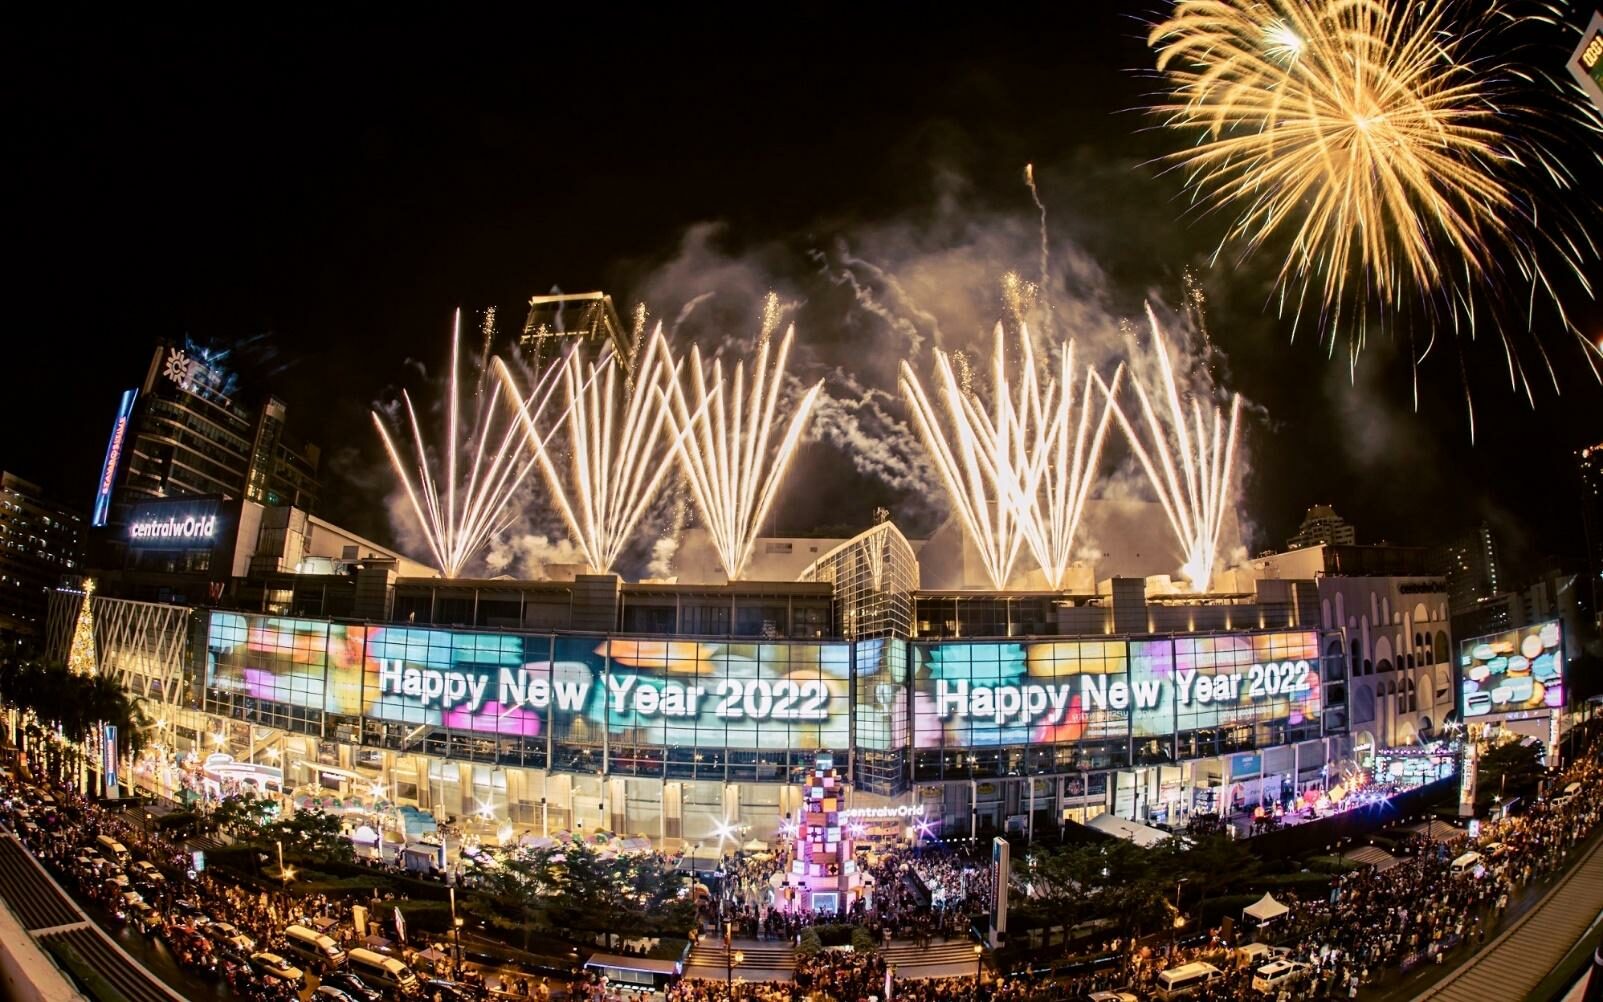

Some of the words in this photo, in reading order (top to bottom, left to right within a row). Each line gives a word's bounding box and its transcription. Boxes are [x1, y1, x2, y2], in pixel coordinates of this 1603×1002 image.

[131, 515, 216, 538] centralwOrld
[377, 658, 488, 712] Happy
[501, 667, 590, 712] New
[600, 673, 705, 718] Year
[715, 678, 829, 721] 2022
[935, 678, 1070, 725] Happy
[1081, 673, 1162, 711] New
[1170, 668, 1242, 707] Year
[1248, 660, 1311, 697] 2022
